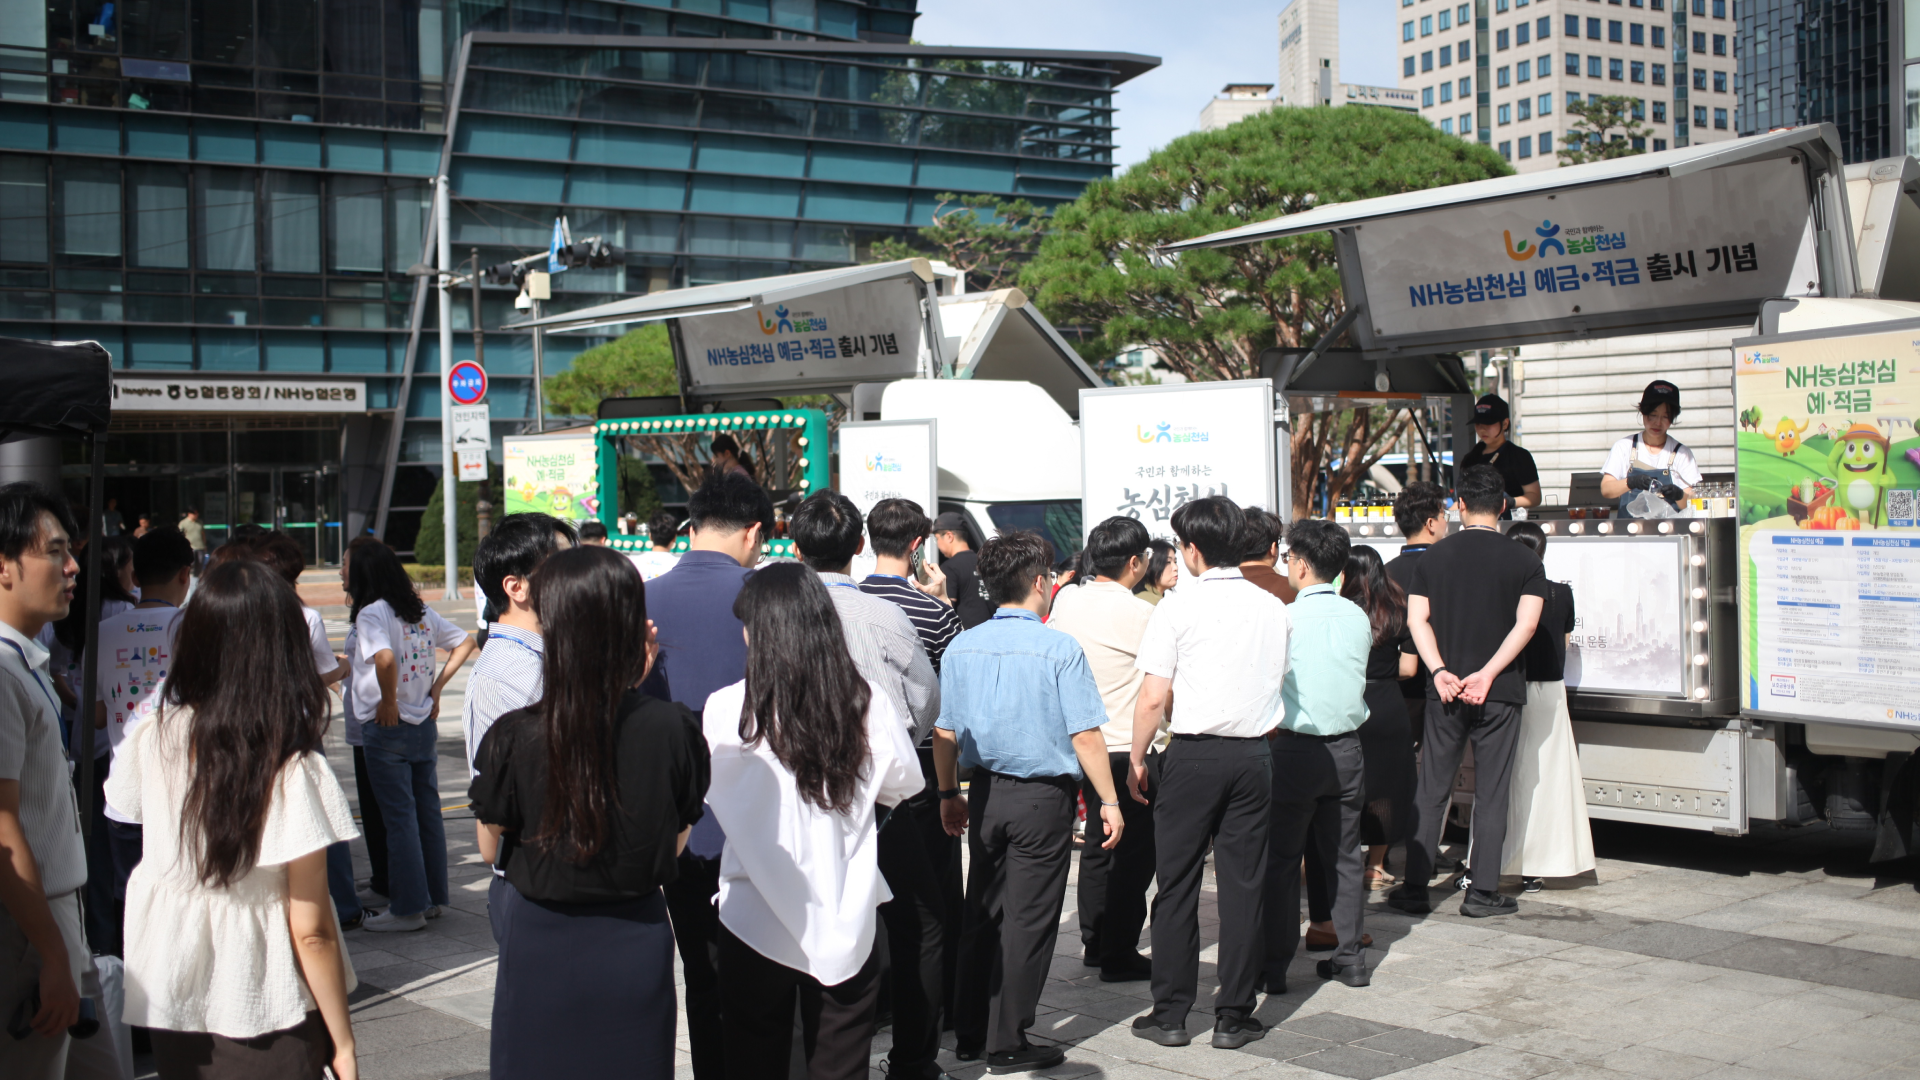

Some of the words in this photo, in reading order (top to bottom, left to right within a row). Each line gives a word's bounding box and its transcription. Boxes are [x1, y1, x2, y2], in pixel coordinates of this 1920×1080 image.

[1566, 231, 1627, 255] 농심천심
[1408, 270, 1527, 308] NH농심천심
[1646, 250, 1698, 282] 출시
[1706, 242, 1759, 274] 기념
[792, 317, 828, 333] 농심천심
[707, 342, 775, 366] NH농심천심
[838, 335, 867, 358] 출시
[869, 332, 900, 356] 기념
[1785, 358, 1896, 389] NH농심천심
[1173, 431, 1209, 443] 농심천심
[526, 453, 575, 468] NH농심천심
[1135, 466, 1166, 478] 국민과
[1170, 464, 1212, 478] 함께하는
[1587, 635, 1608, 649] 운동
[115, 645, 168, 669] 도시와
